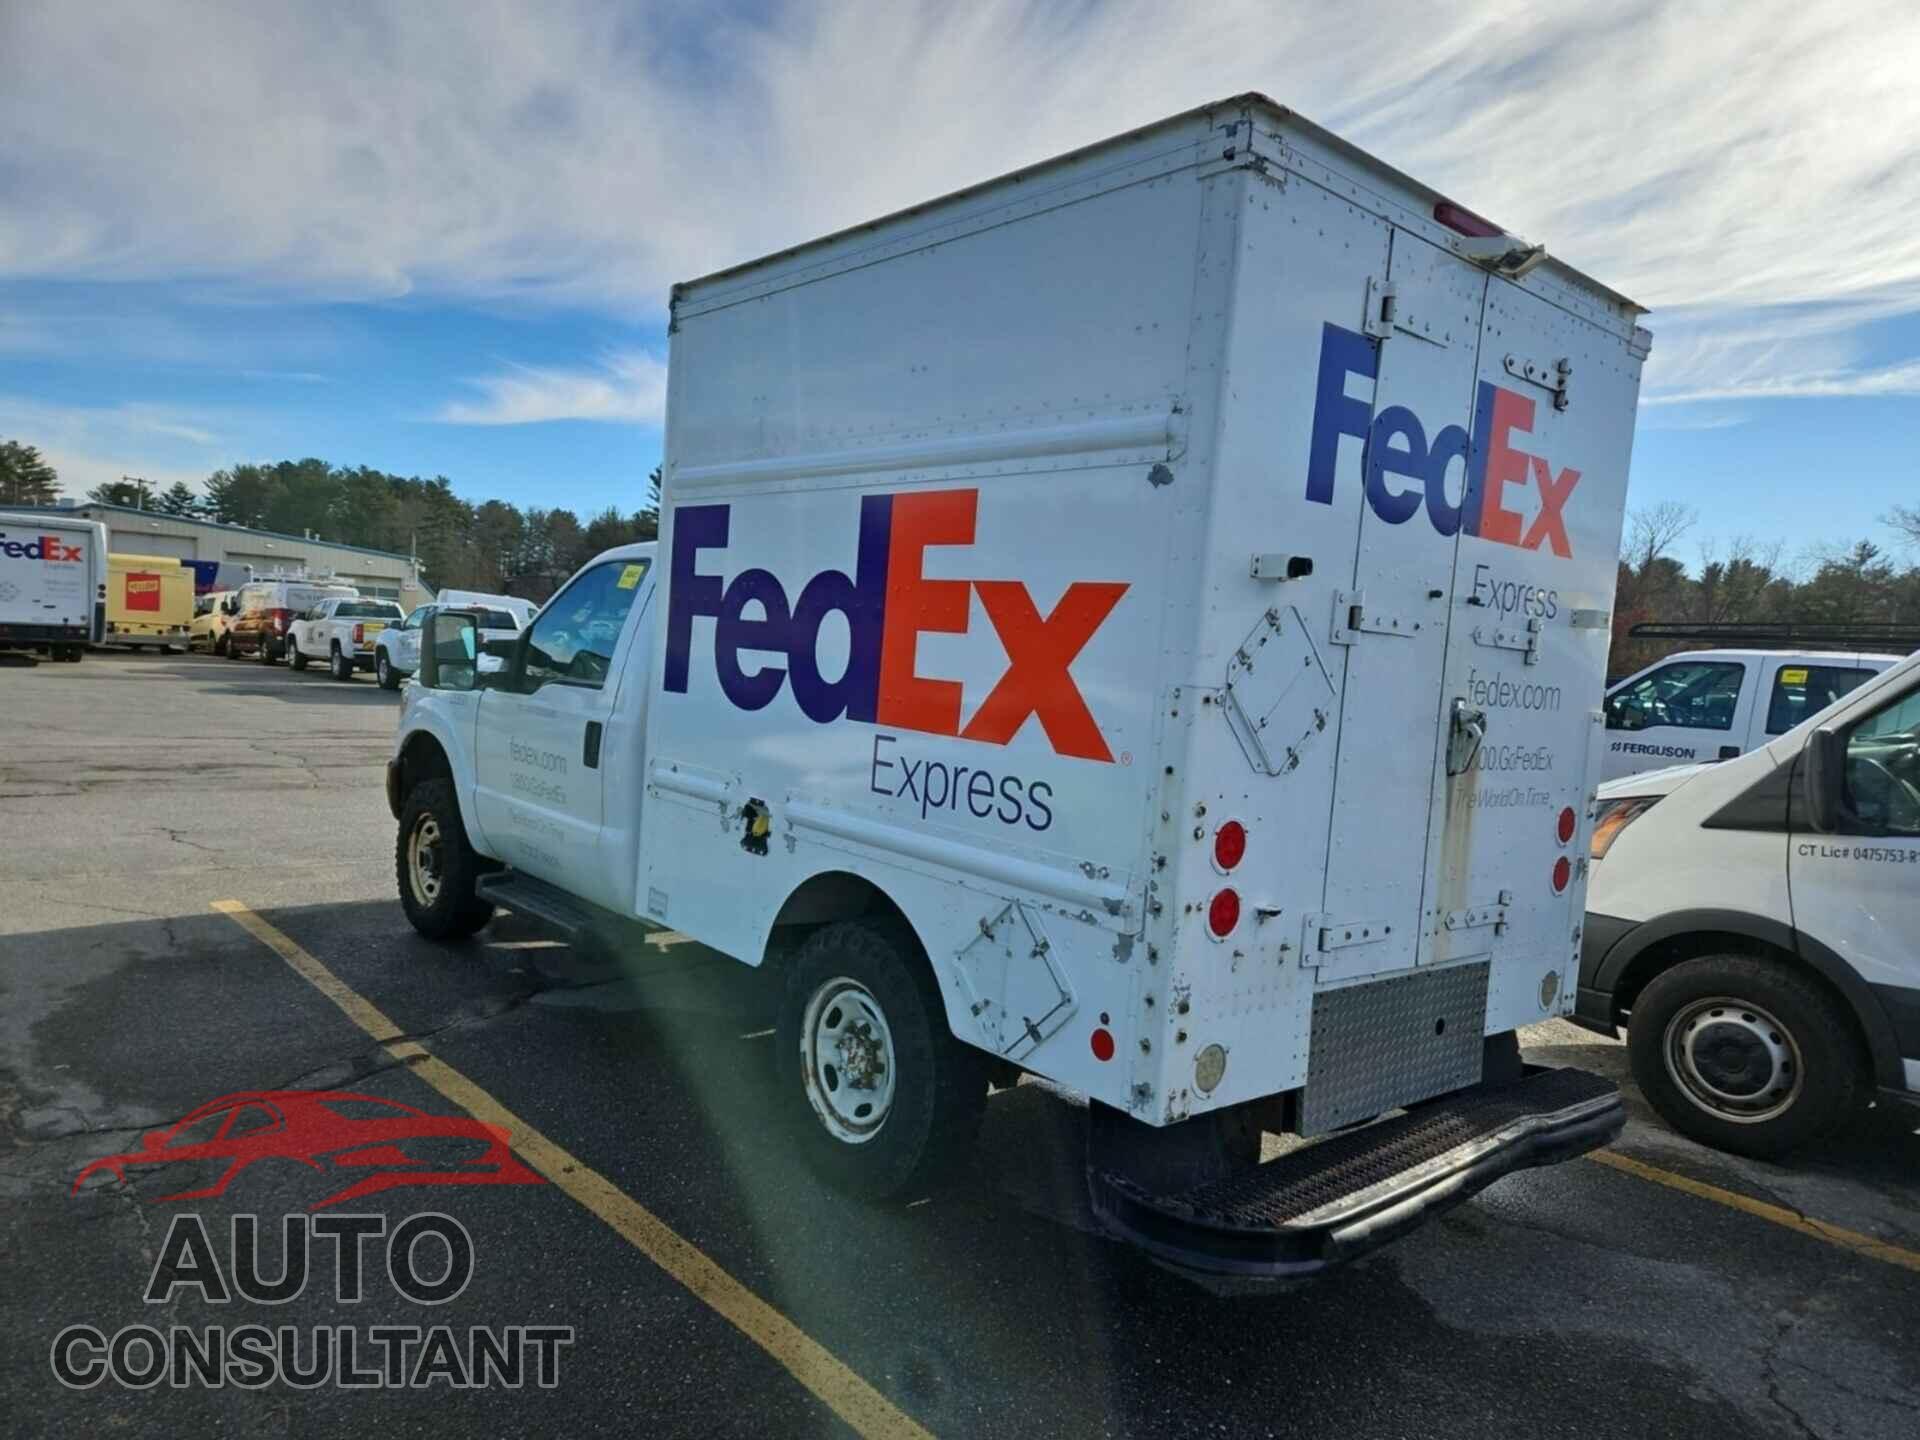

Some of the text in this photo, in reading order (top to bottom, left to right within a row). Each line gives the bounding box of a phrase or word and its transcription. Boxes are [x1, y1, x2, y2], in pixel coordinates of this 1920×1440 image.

[1305, 321, 1582, 560] FedEx
[1473, 564, 1558, 621] Express
[663, 488, 1132, 764] FedEx
[1467, 671, 1562, 711] fedex.com
[1623, 742, 1696, 759] FERGUSON
[871, 733, 1053, 832] Express
[1798, 843, 1920, 864] CT Lic# 0475753-R
